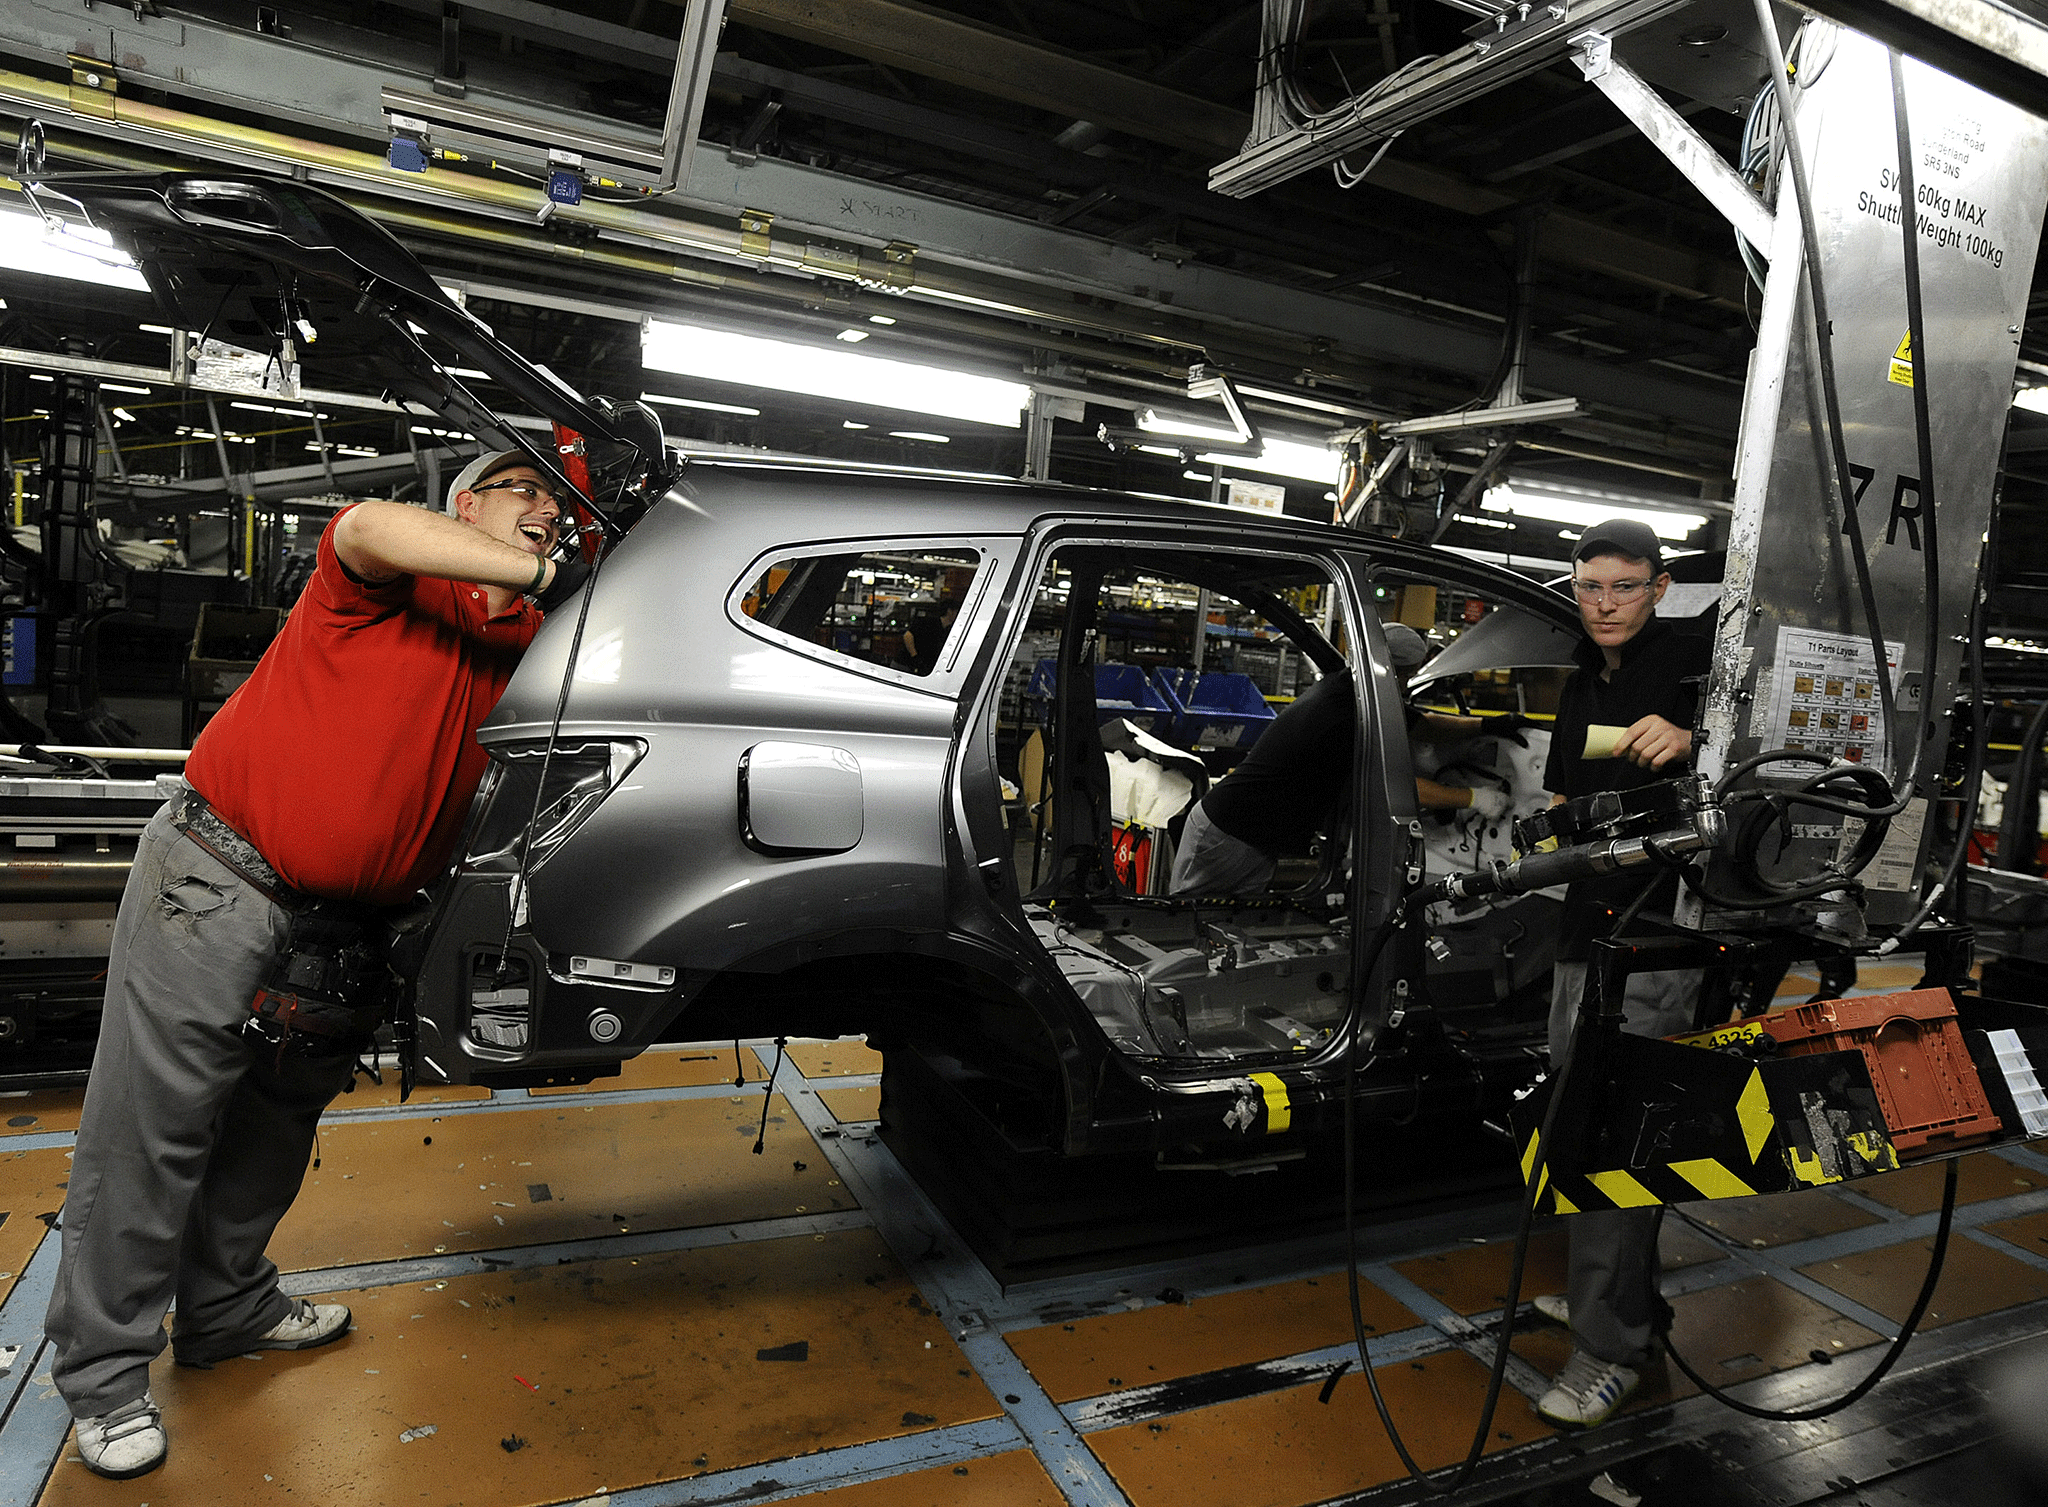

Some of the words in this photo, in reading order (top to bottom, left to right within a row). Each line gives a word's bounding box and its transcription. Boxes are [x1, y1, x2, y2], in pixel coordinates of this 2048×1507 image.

[1962, 133, 1986, 153] Road
[1923, 153, 1942, 171] SR5
[1942, 162, 1960, 179] 3NS
[1917, 184, 1951, 218] 60kg
[1954, 198, 1987, 228] MAX
[1857, 191, 1903, 226] Shuttl
[1915, 212, 1962, 248] Weight
[1966, 233, 2003, 268] 100kg
[1885, 474, 1923, 552] R
[1817, 643, 1835, 655] Parts
[1836, 646, 1859, 658] Layout
